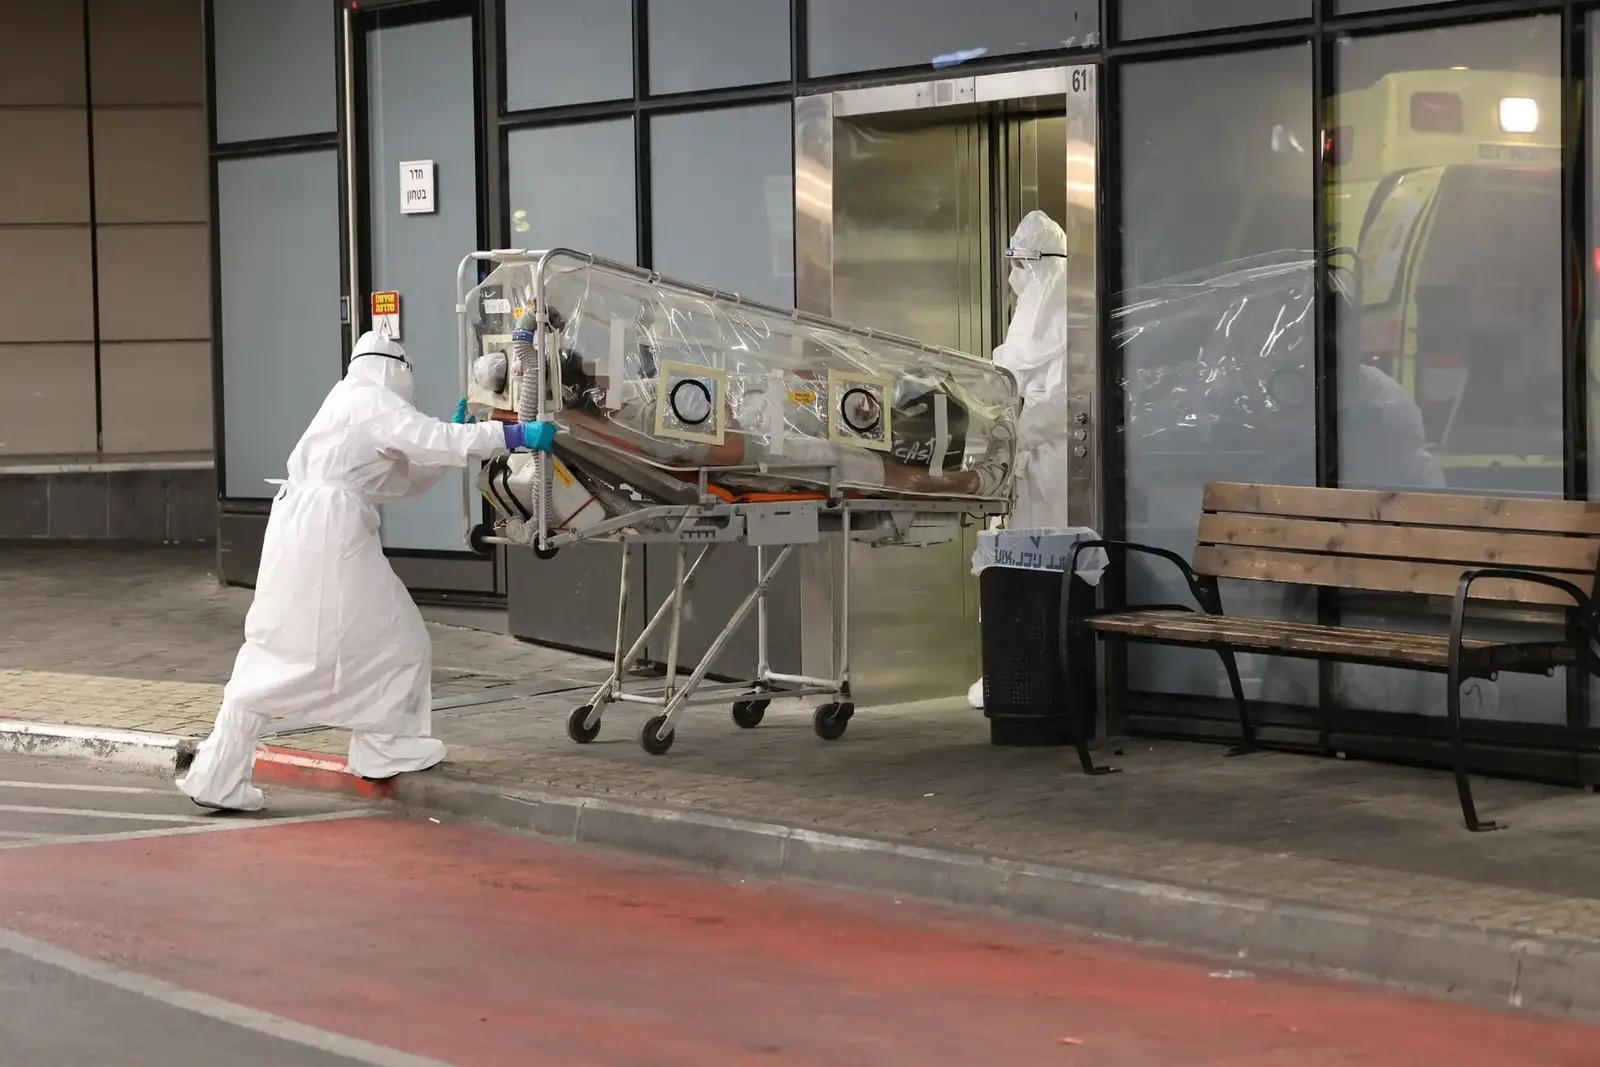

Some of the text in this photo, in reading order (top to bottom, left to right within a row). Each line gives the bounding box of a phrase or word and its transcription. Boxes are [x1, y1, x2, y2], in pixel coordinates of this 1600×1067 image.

[1072, 69, 1087, 93] 61
[409, 168, 424, 180] חדר
[406, 189, 427, 205] בטחון
